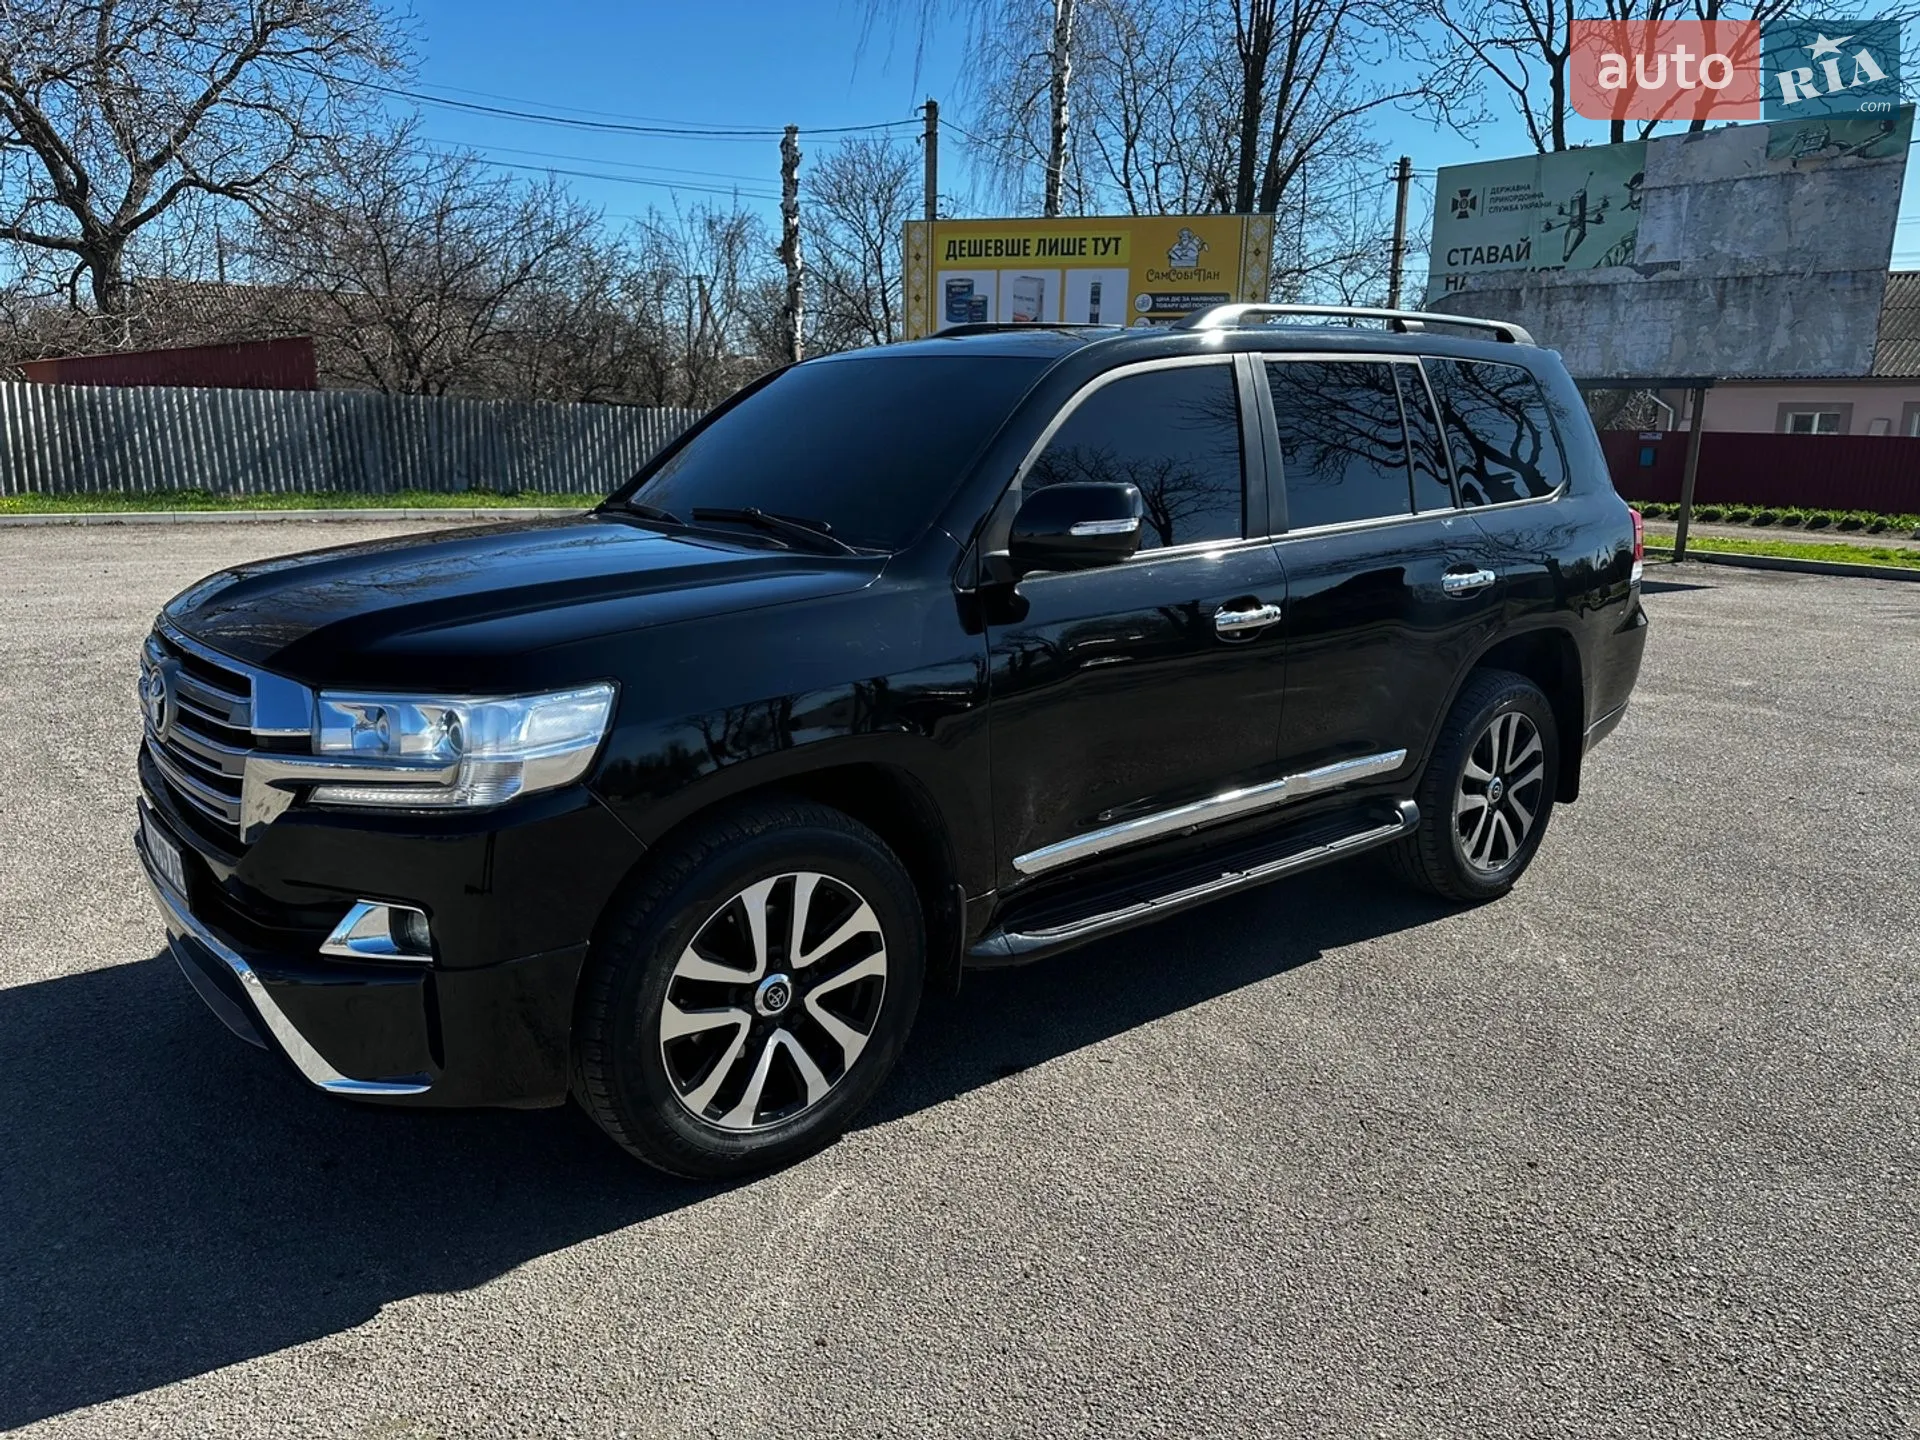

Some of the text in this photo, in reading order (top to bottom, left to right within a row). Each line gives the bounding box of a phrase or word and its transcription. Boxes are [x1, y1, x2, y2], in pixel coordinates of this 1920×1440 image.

[1490, 183, 1531, 195] ДЕРЖАВНА
[1489, 191, 1545, 204] ПРИКОРДОННА
[1488, 200, 1552, 213] СЛУЖБА УКРАЇНИ
[945, 236, 1122, 261] ДЕШЕВШЕ ЛИШЕ ТУТ
[1446, 236, 1532, 267] СТАВАЙ
